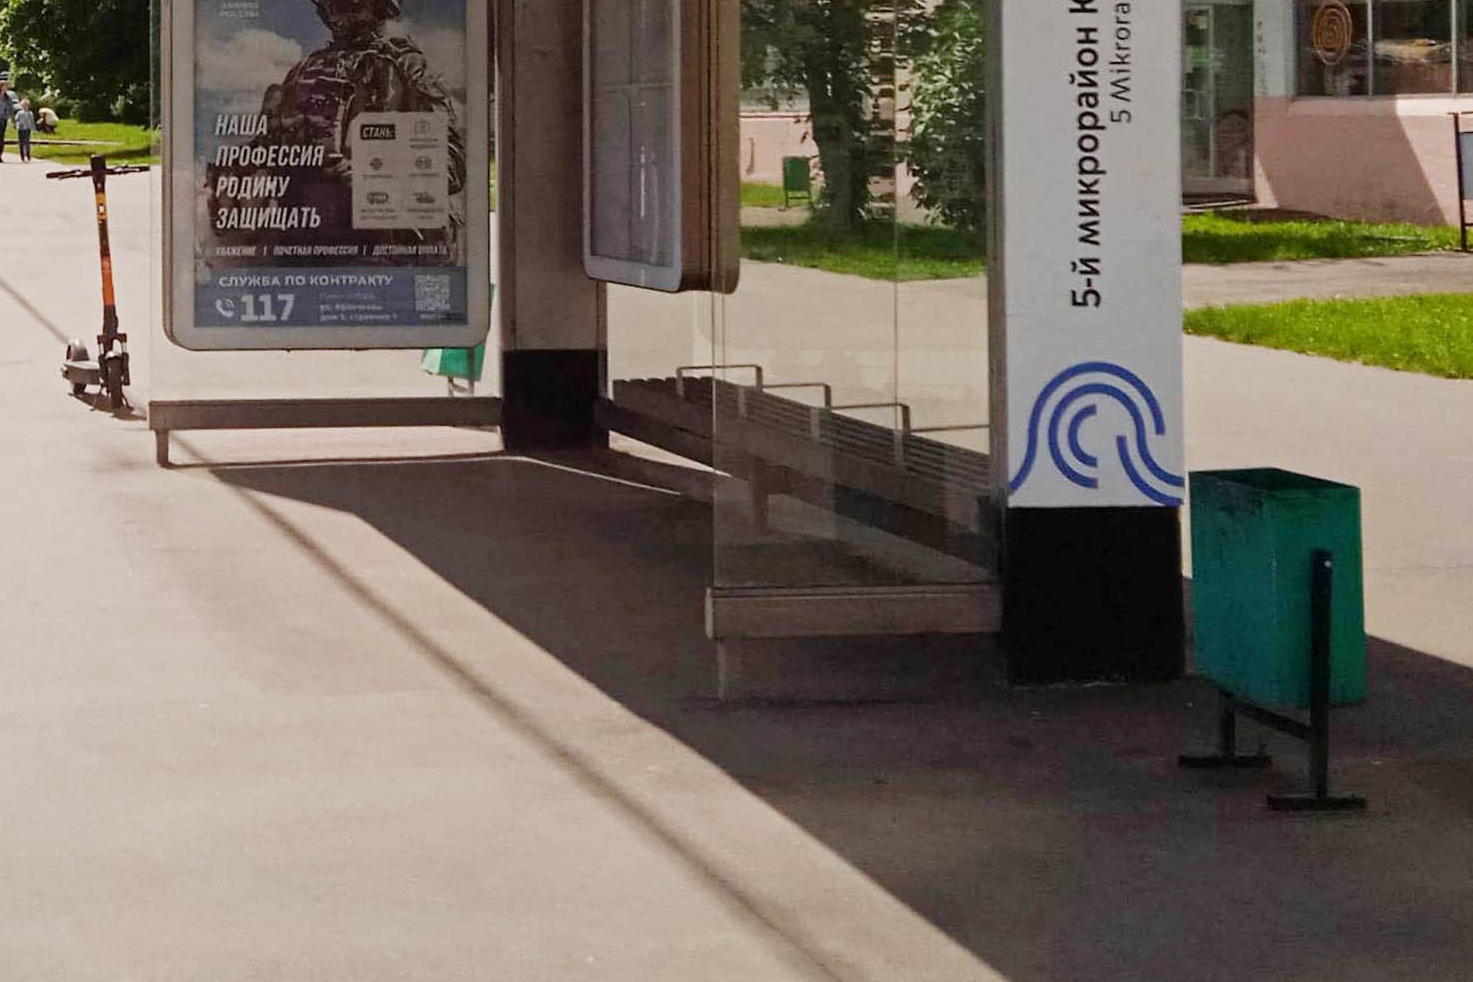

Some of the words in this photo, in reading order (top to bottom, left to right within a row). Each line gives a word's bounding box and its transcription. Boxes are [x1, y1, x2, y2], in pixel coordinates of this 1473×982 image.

[215, 114, 268, 135] НАША
[1110, 109, 1132, 123] 5
[1069, 27, 1107, 246] микрорайон
[215, 145, 325, 167] ПРОФЕССИЯ
[215, 176, 291, 200] РОДИНУ
[216, 207, 322, 231] ЗАЩИЩАТЬ
[218, 275, 281, 287] СЛУЖБА
[285, 275, 305, 286] ПО
[310, 274, 393, 287] КОНТРАКТУ
[1070, 257, 1102, 309] 5-й
[240, 293, 296, 322] 117
